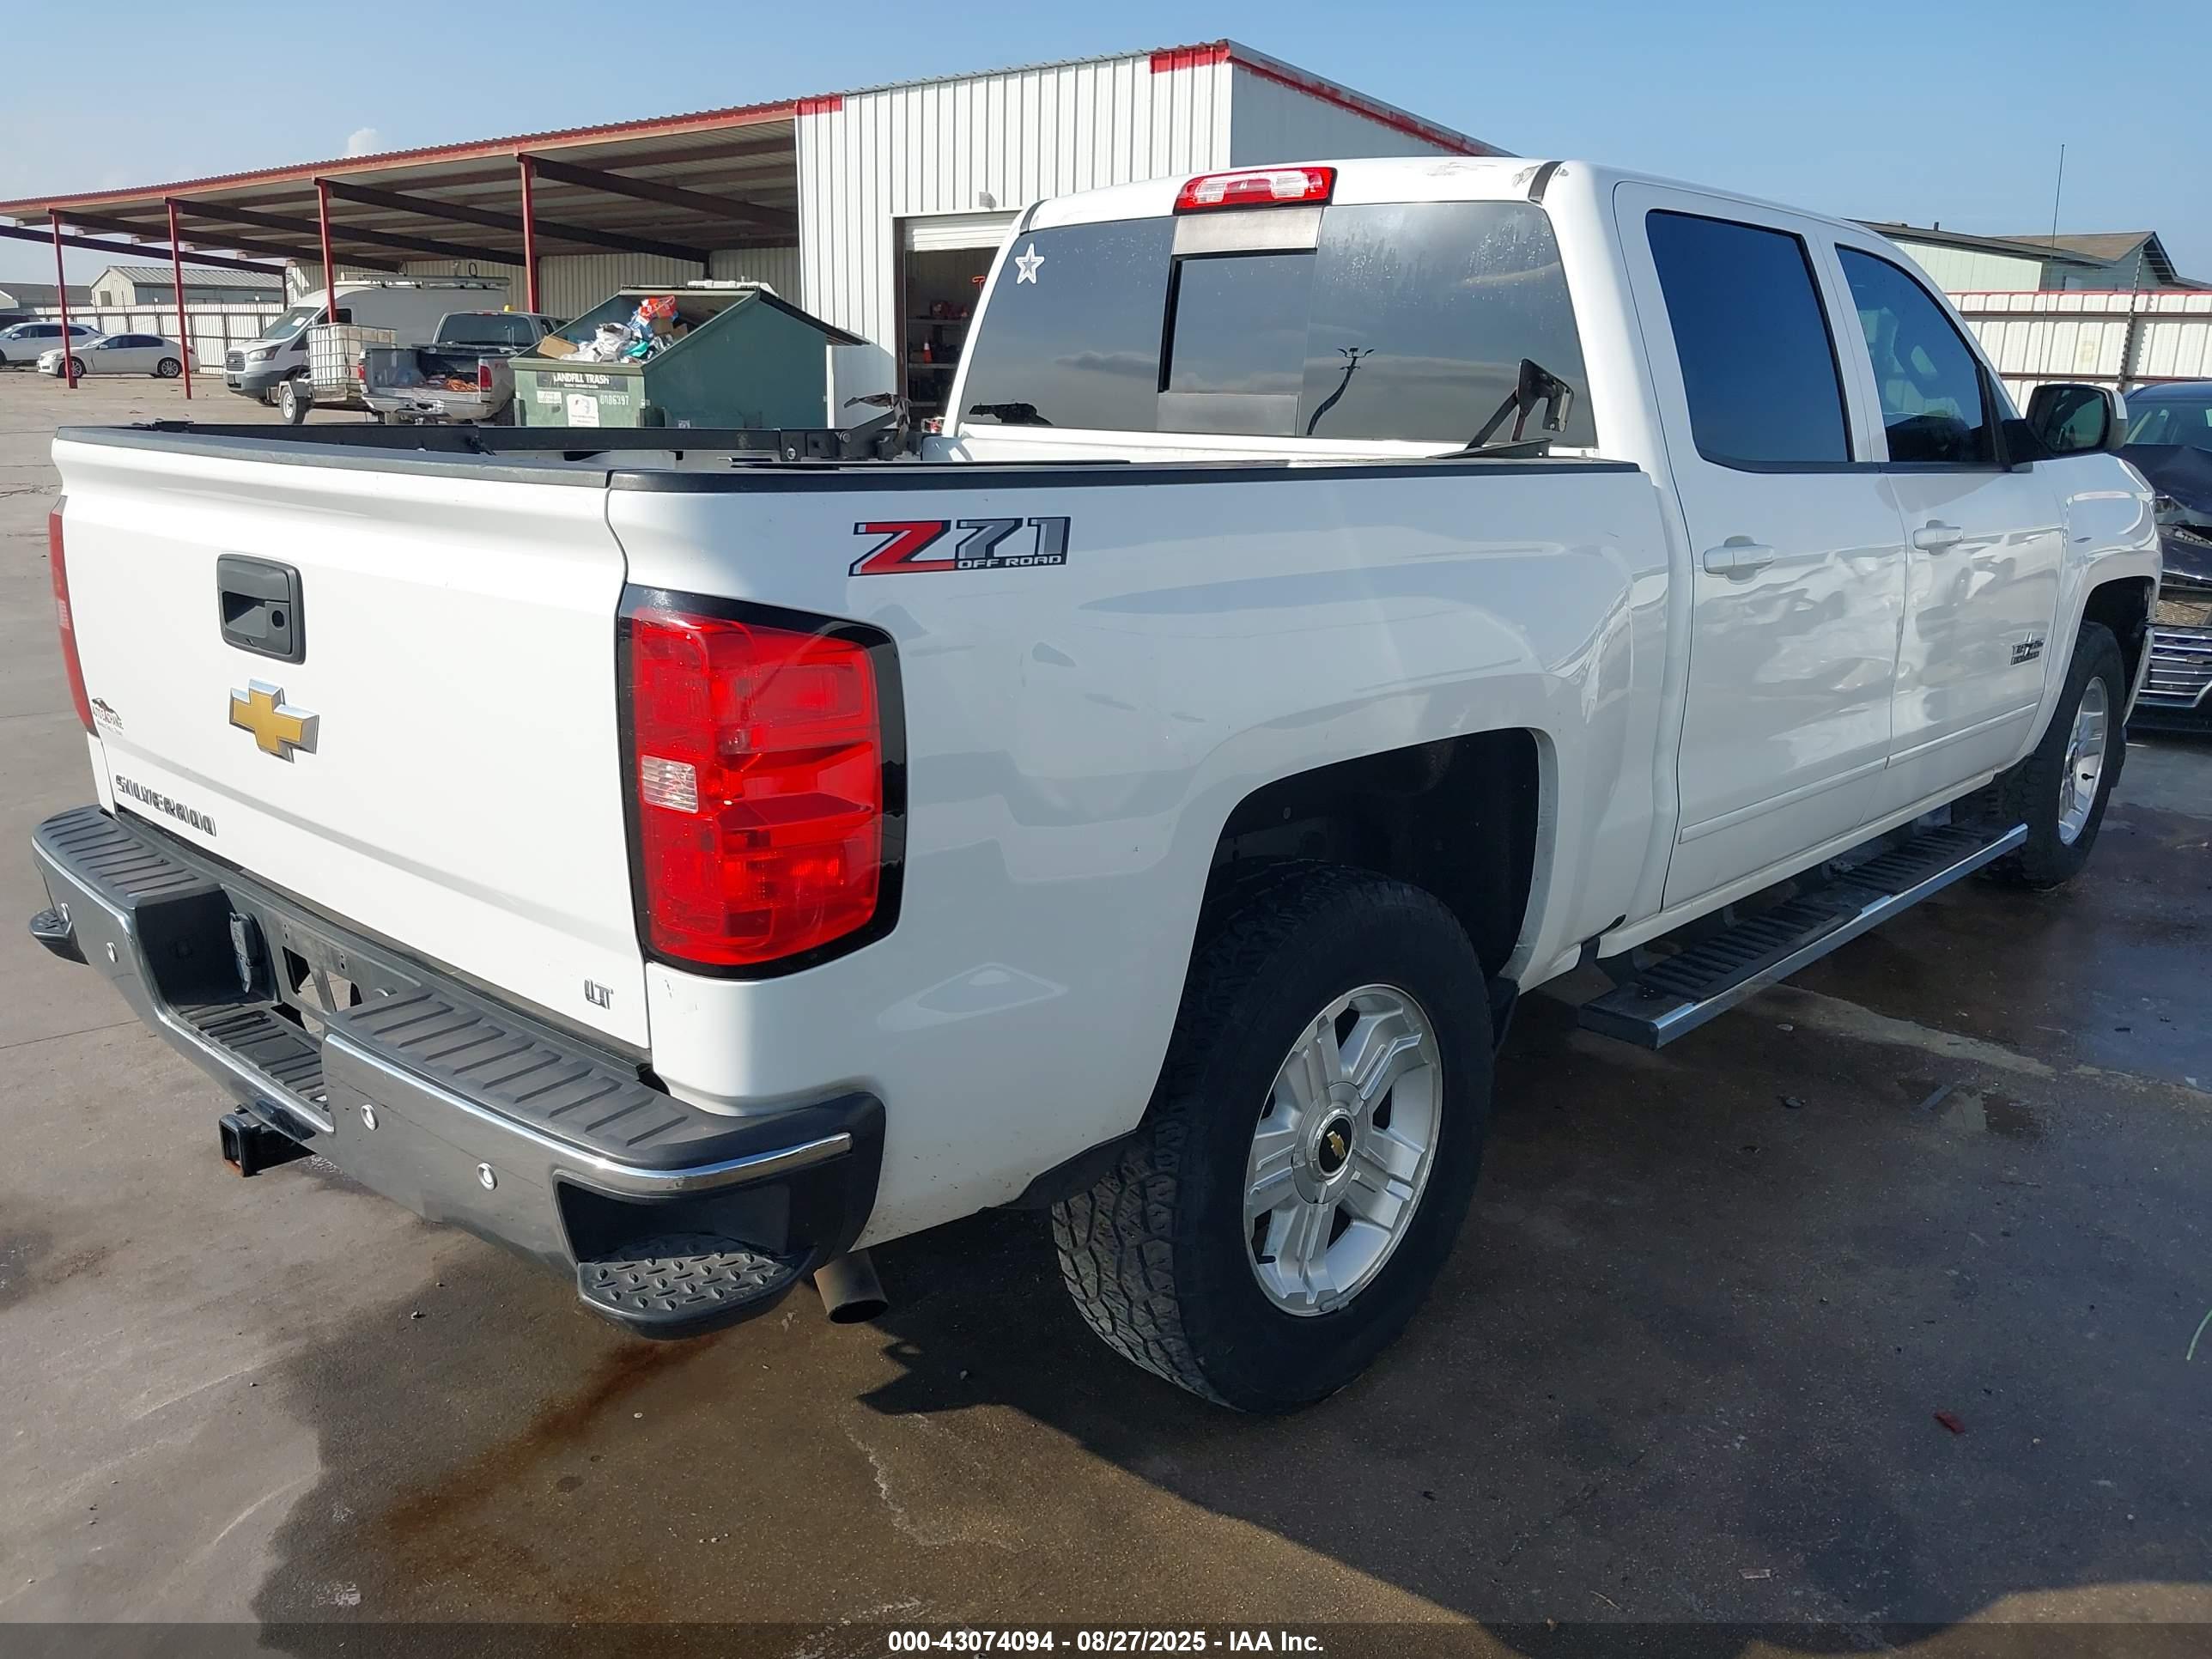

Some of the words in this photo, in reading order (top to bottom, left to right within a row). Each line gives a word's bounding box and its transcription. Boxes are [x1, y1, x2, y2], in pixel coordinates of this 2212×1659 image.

[585, 374, 610, 386] TRASH
[848, 516, 1072, 577] Z71
[957, 558, 1000, 569] OFF
[1005, 555, 1062, 567] ROAD
[115, 775, 217, 837] SILVERADO
[584, 978, 614, 1010] LT
